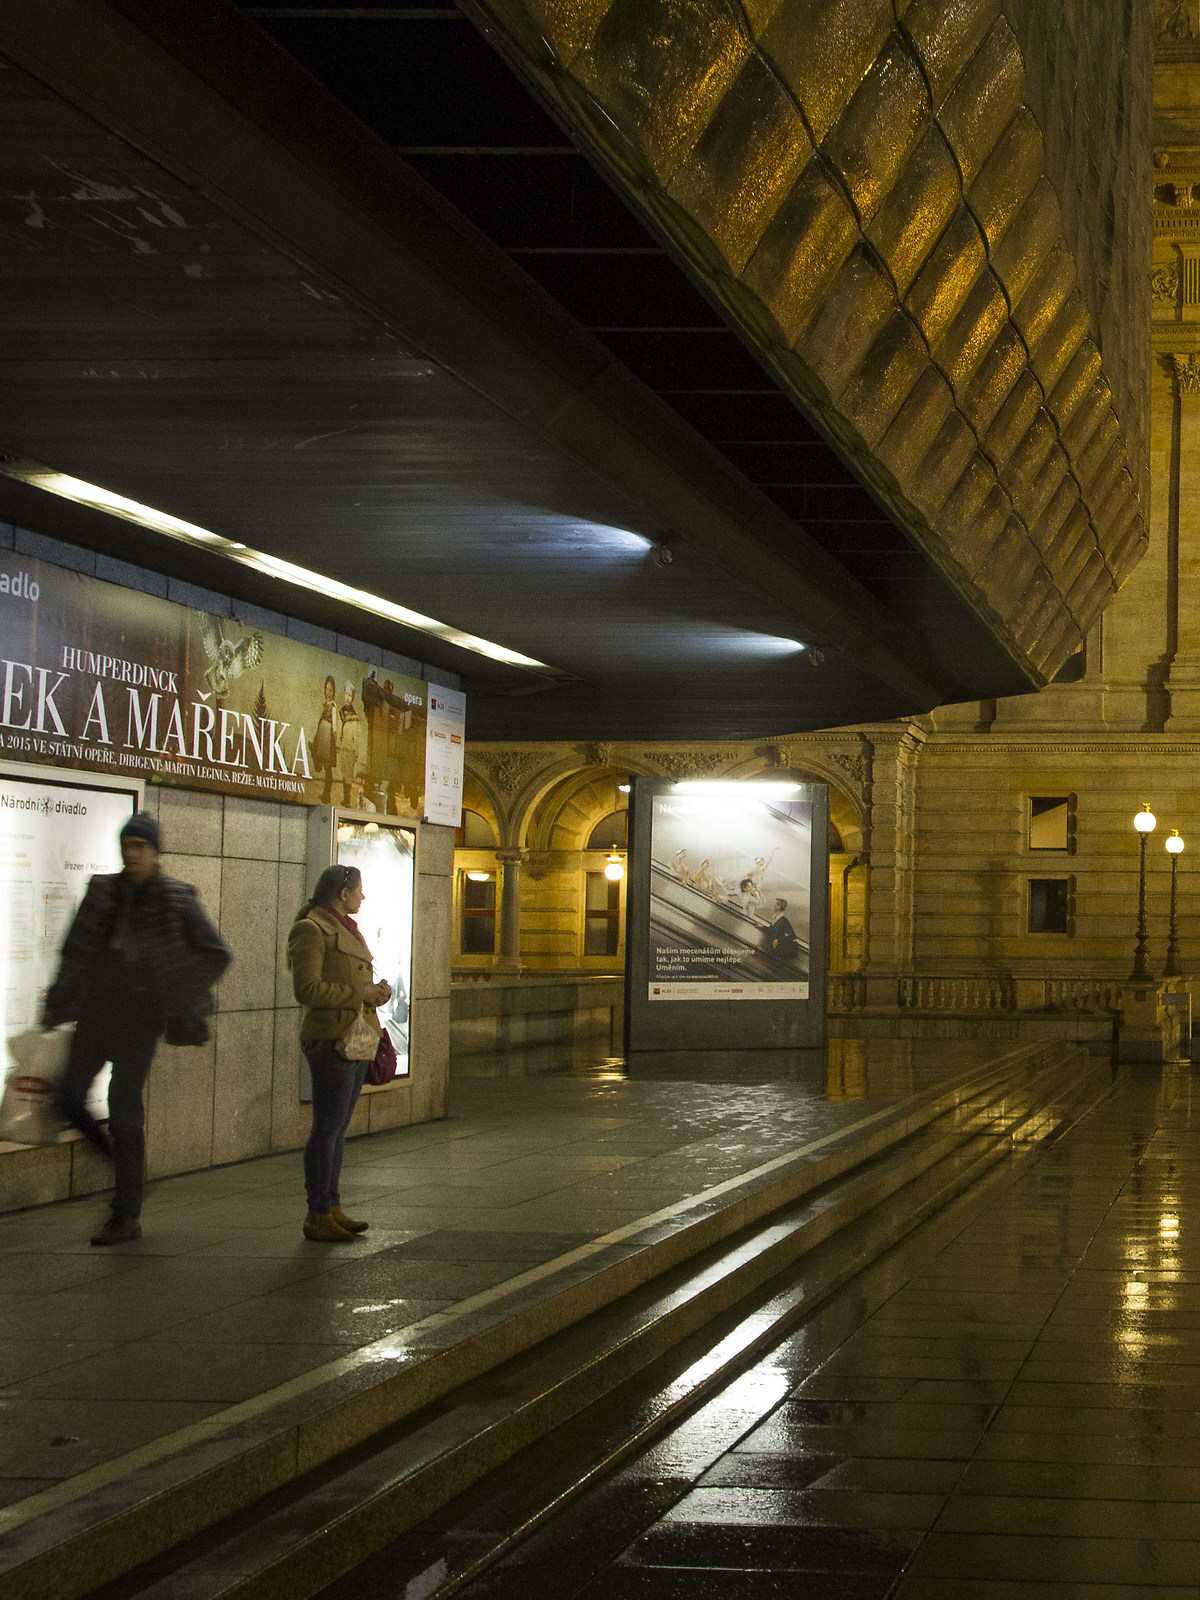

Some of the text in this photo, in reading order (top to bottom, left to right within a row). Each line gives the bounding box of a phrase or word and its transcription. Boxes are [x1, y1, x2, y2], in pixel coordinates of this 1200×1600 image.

[0, 569, 40, 601] adlo
[62, 646, 178, 694] HUMPERDINCK
[404, 692, 423, 706] opera
[78, 680, 114, 745] A
[123, 687, 313, 780] MAŘENKA
[7, 734, 31, 751] 2015
[32, 738, 47, 754] VE
[49, 740, 84, 760] STÁTNÍ
[84, 747, 117, 765] OPEŘE,
[119, 753, 163, 772] DIRIGENT:
[164, 760, 196, 777] MARTIN
[196, 766, 231, 783] LEGINUS,
[231, 770, 256, 786] REŽIE:
[256, 775, 278, 790] MATĚJ
[278, 781, 306, 793] FORMAN
[1, 794, 87, 816] Národní divadlo
[656, 955, 669, 964] tak,
[670, 955, 681, 964] jak
